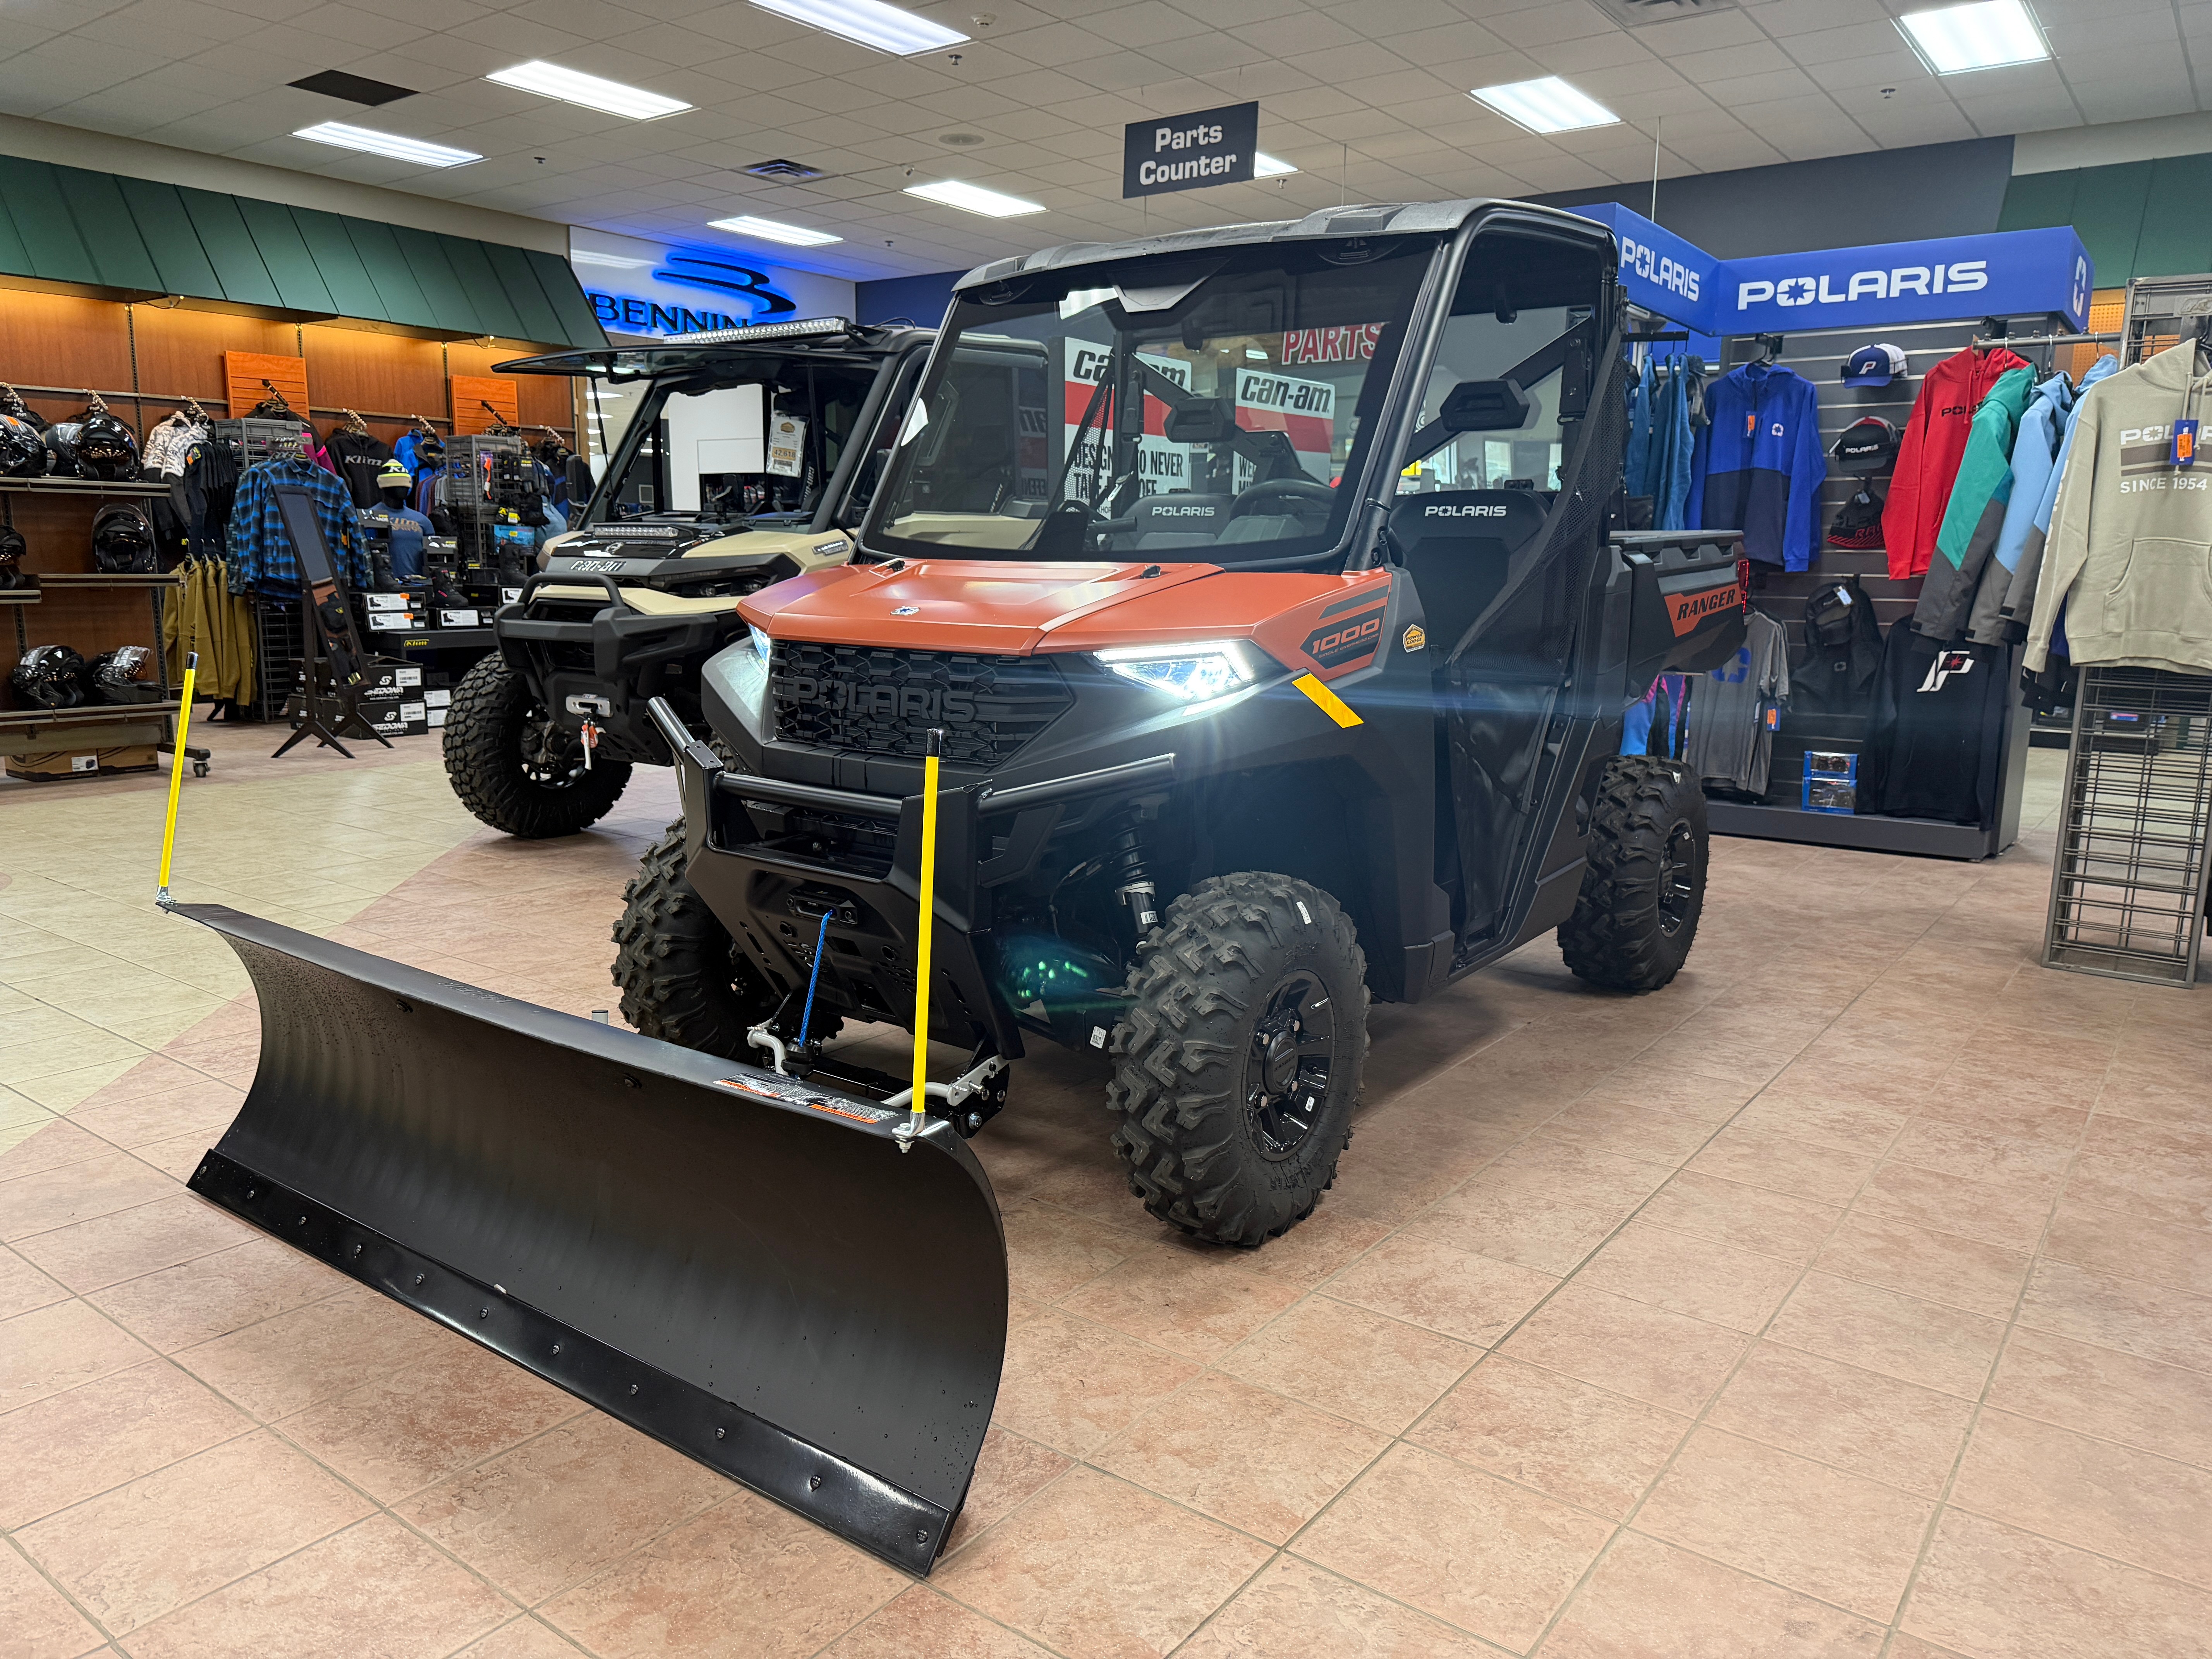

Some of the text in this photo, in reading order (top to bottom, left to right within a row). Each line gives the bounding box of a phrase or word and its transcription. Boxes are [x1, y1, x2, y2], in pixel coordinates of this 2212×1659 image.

[1155, 124, 1222, 153] Parts
[1140, 154, 1237, 185] Counter
[1620, 236, 1700, 302] POLARIS
[1738, 261, 1988, 311] POLARIS
[589, 293, 751, 332] BENNIN
[1282, 324, 1379, 365] PARTS
[1241, 375, 1331, 413] can-am
[1151, 450, 1183, 477] NEVER
[2120, 477, 2207, 493] SINCE 1954
[1152, 506, 1215, 517] POLARIS
[1425, 506, 1506, 517] POLARIS
[1677, 589, 1735, 621] RANGER
[1312, 618, 1380, 654] 1000
[1319, 649, 1338, 658] SINGLE
[1340, 637, 1367, 651] OVERHEAD
[791, 675, 979, 723] POLARIS
